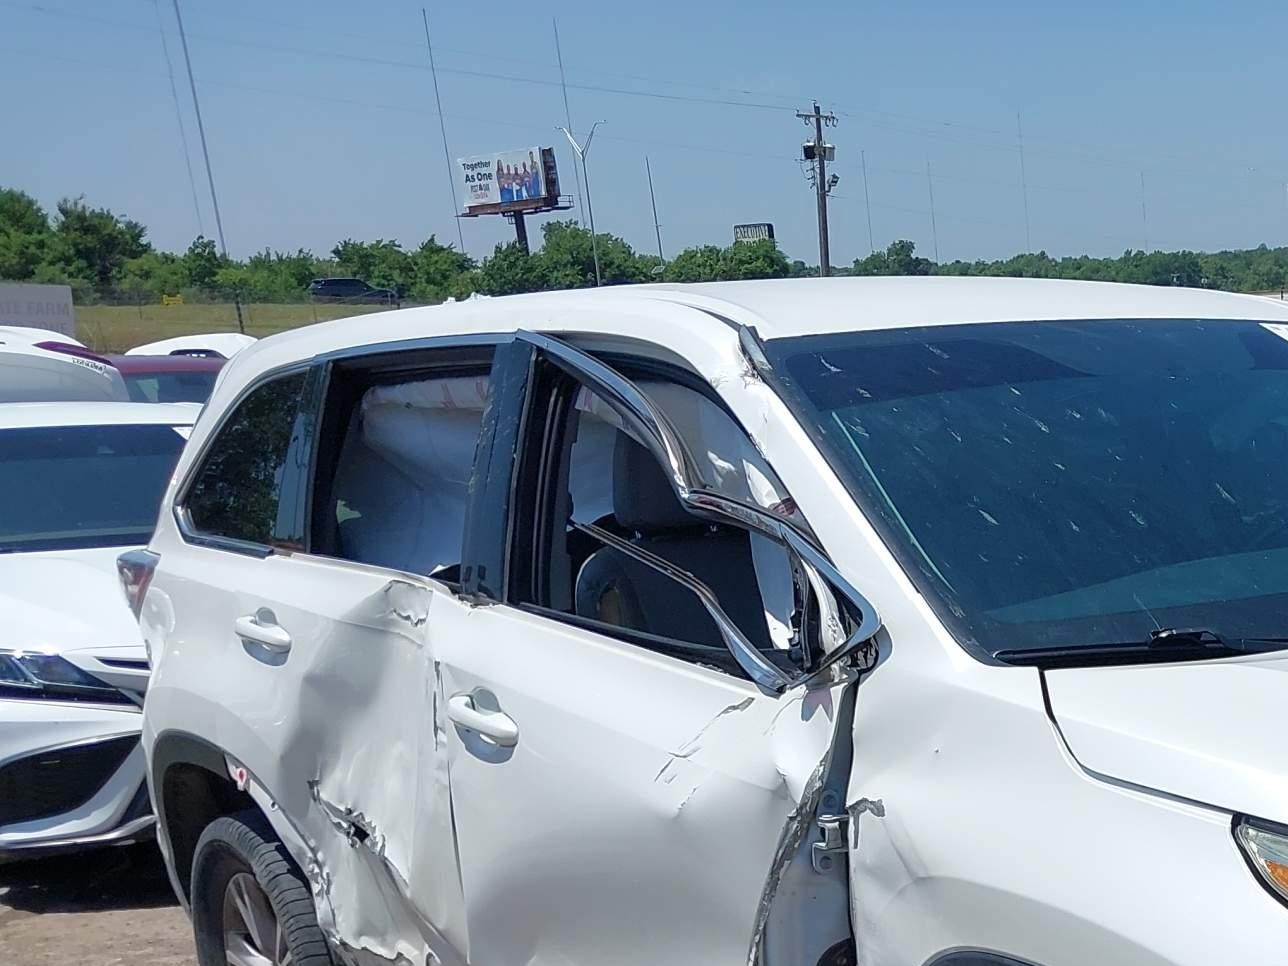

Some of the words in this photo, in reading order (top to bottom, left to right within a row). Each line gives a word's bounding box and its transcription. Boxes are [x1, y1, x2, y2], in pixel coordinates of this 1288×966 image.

[462, 160, 491, 171] Together
[464, 173, 476, 183] As
[476, 171, 493, 181] One
[28, 302, 70, 316] FARM
